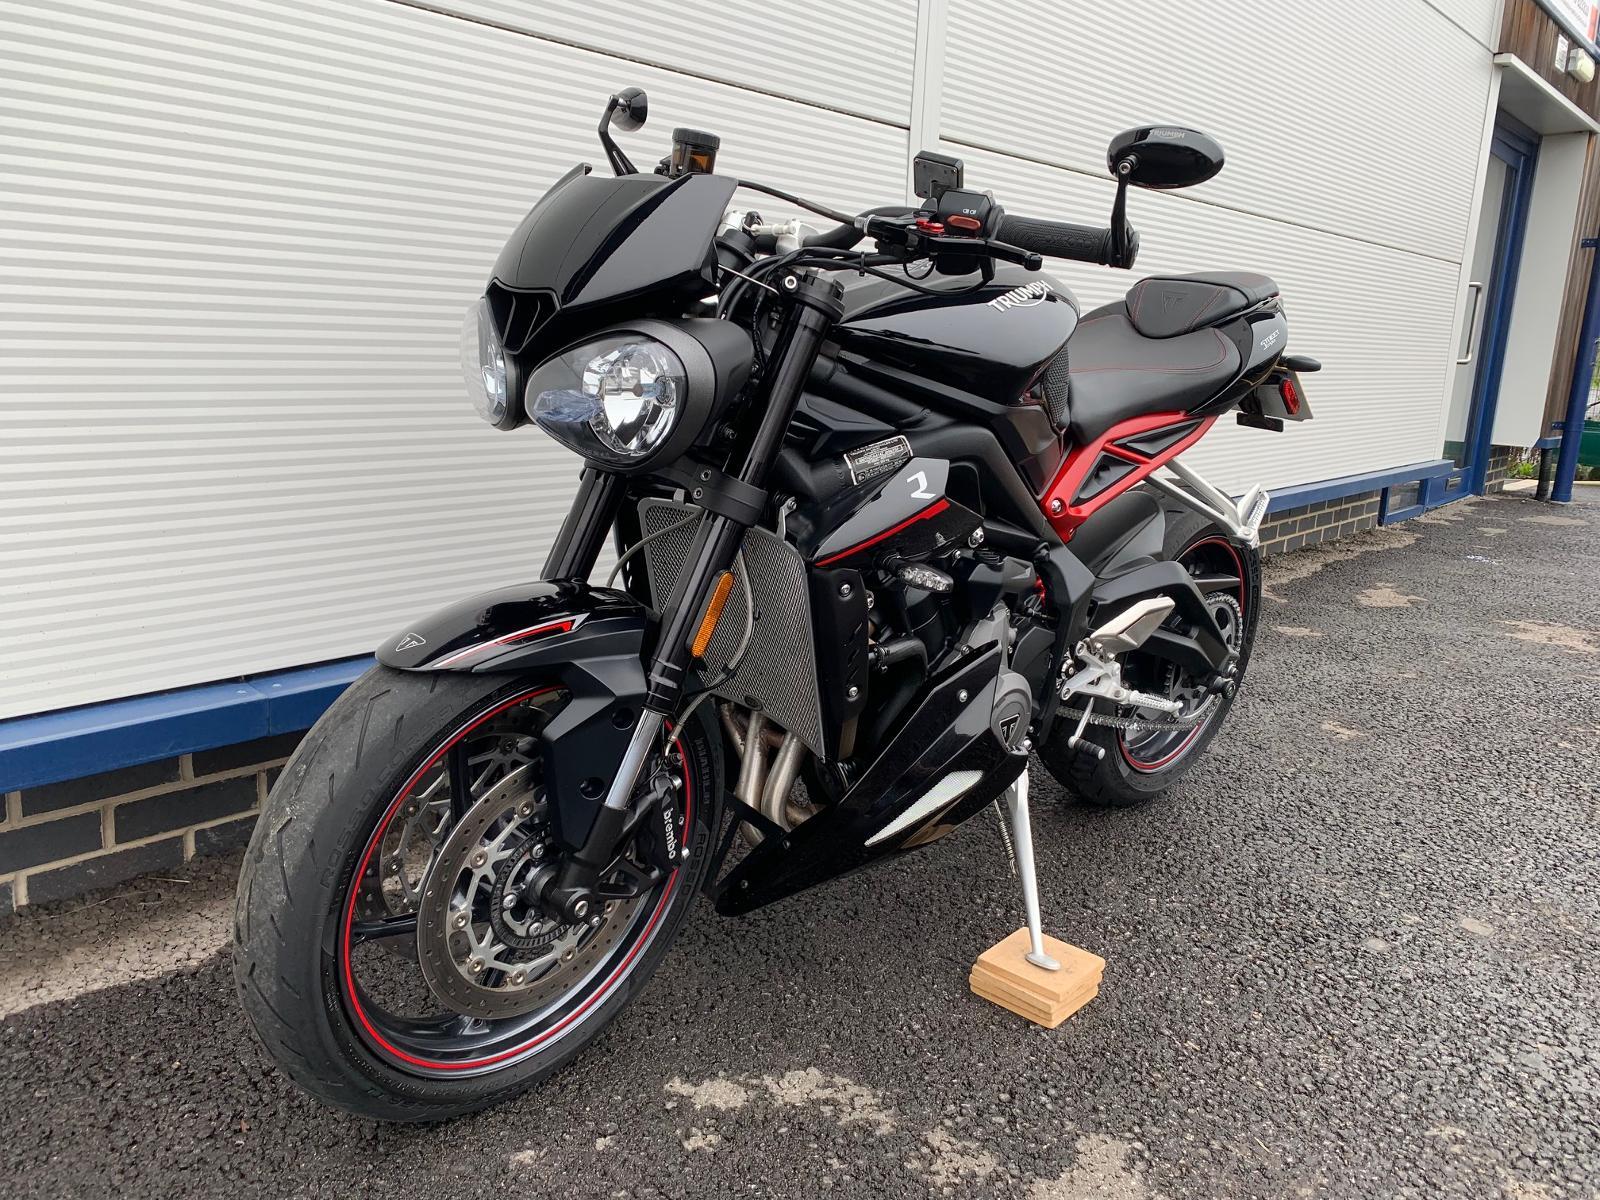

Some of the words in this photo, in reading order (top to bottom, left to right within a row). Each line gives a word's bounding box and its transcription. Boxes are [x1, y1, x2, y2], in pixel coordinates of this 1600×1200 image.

[1149, 129, 1187, 139] TRIUMPH
[987, 279, 1054, 312] TRIUMPH
[663, 807, 677, 860] brembo
